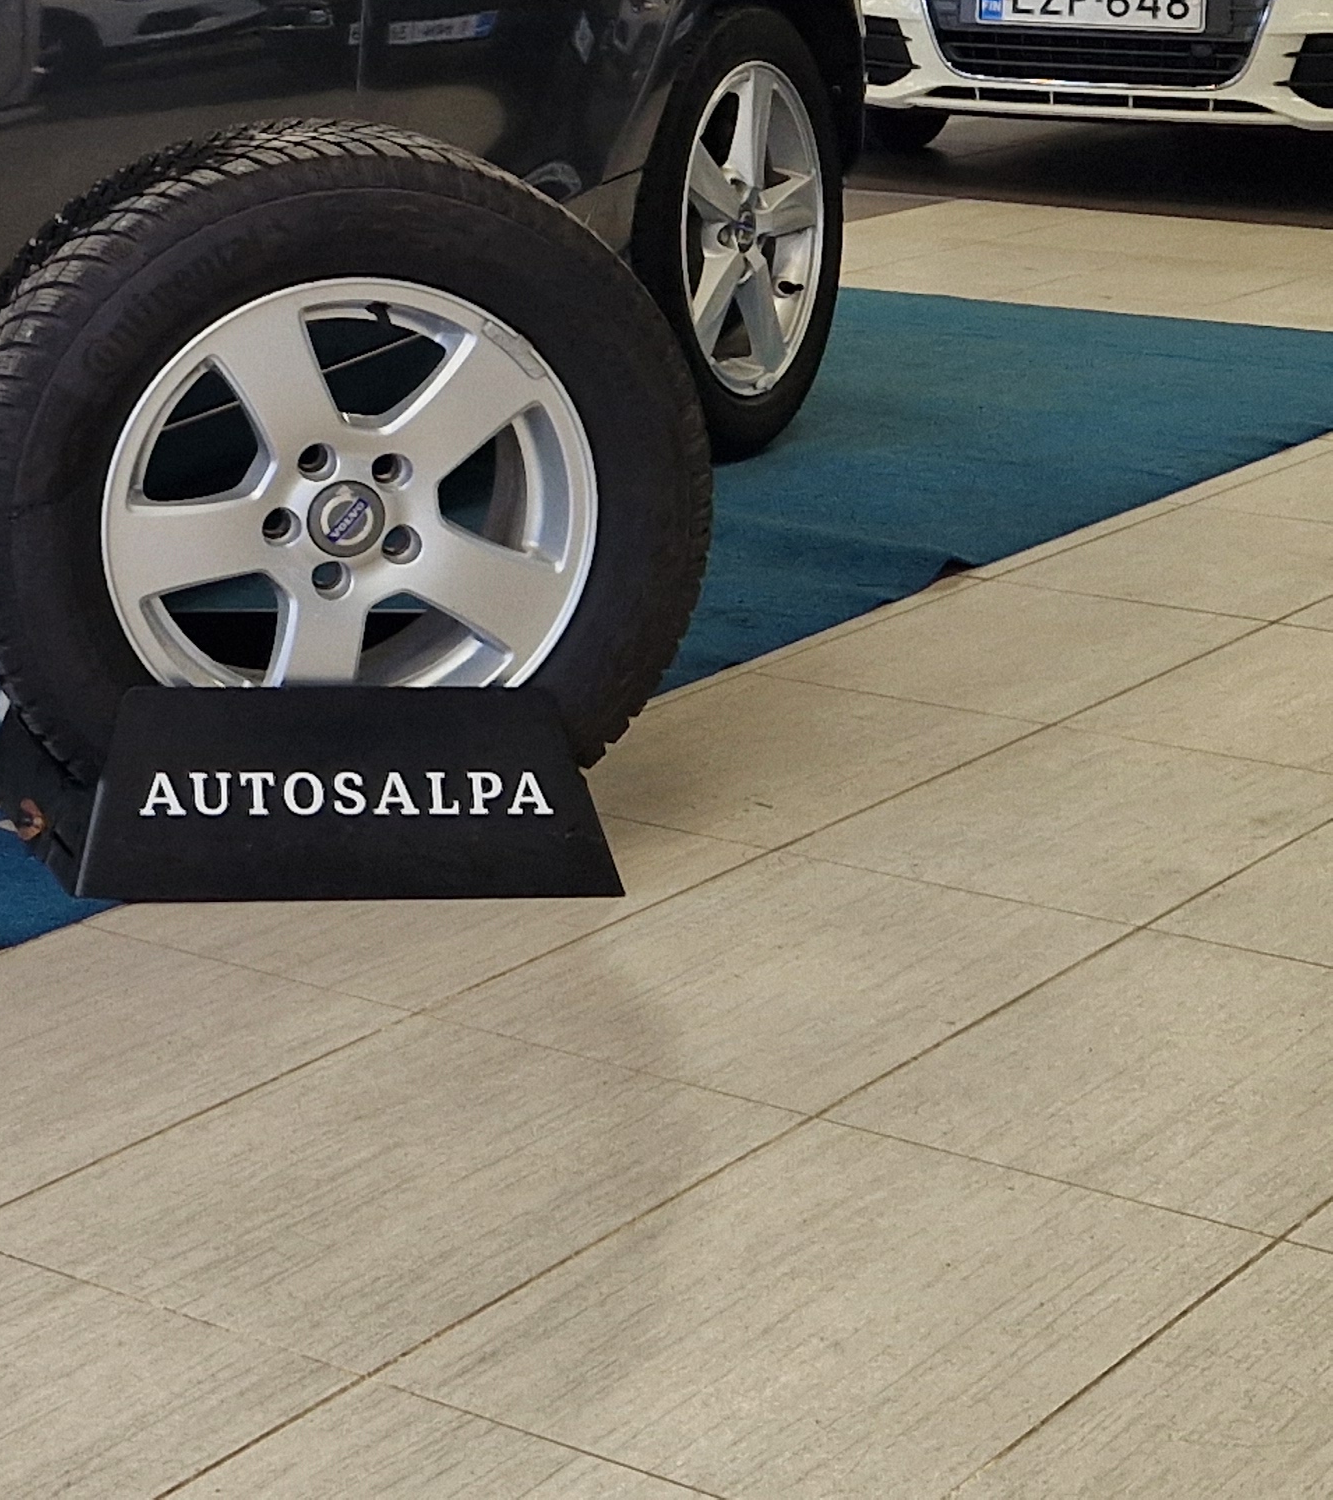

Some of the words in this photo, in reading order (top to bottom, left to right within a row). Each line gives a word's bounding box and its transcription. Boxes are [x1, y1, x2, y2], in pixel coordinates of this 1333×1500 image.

[983, 0, 1002, 12] FIN
[328, 501, 366, 539] VOLVO
[138, 771, 555, 816] AUTOSALPA
